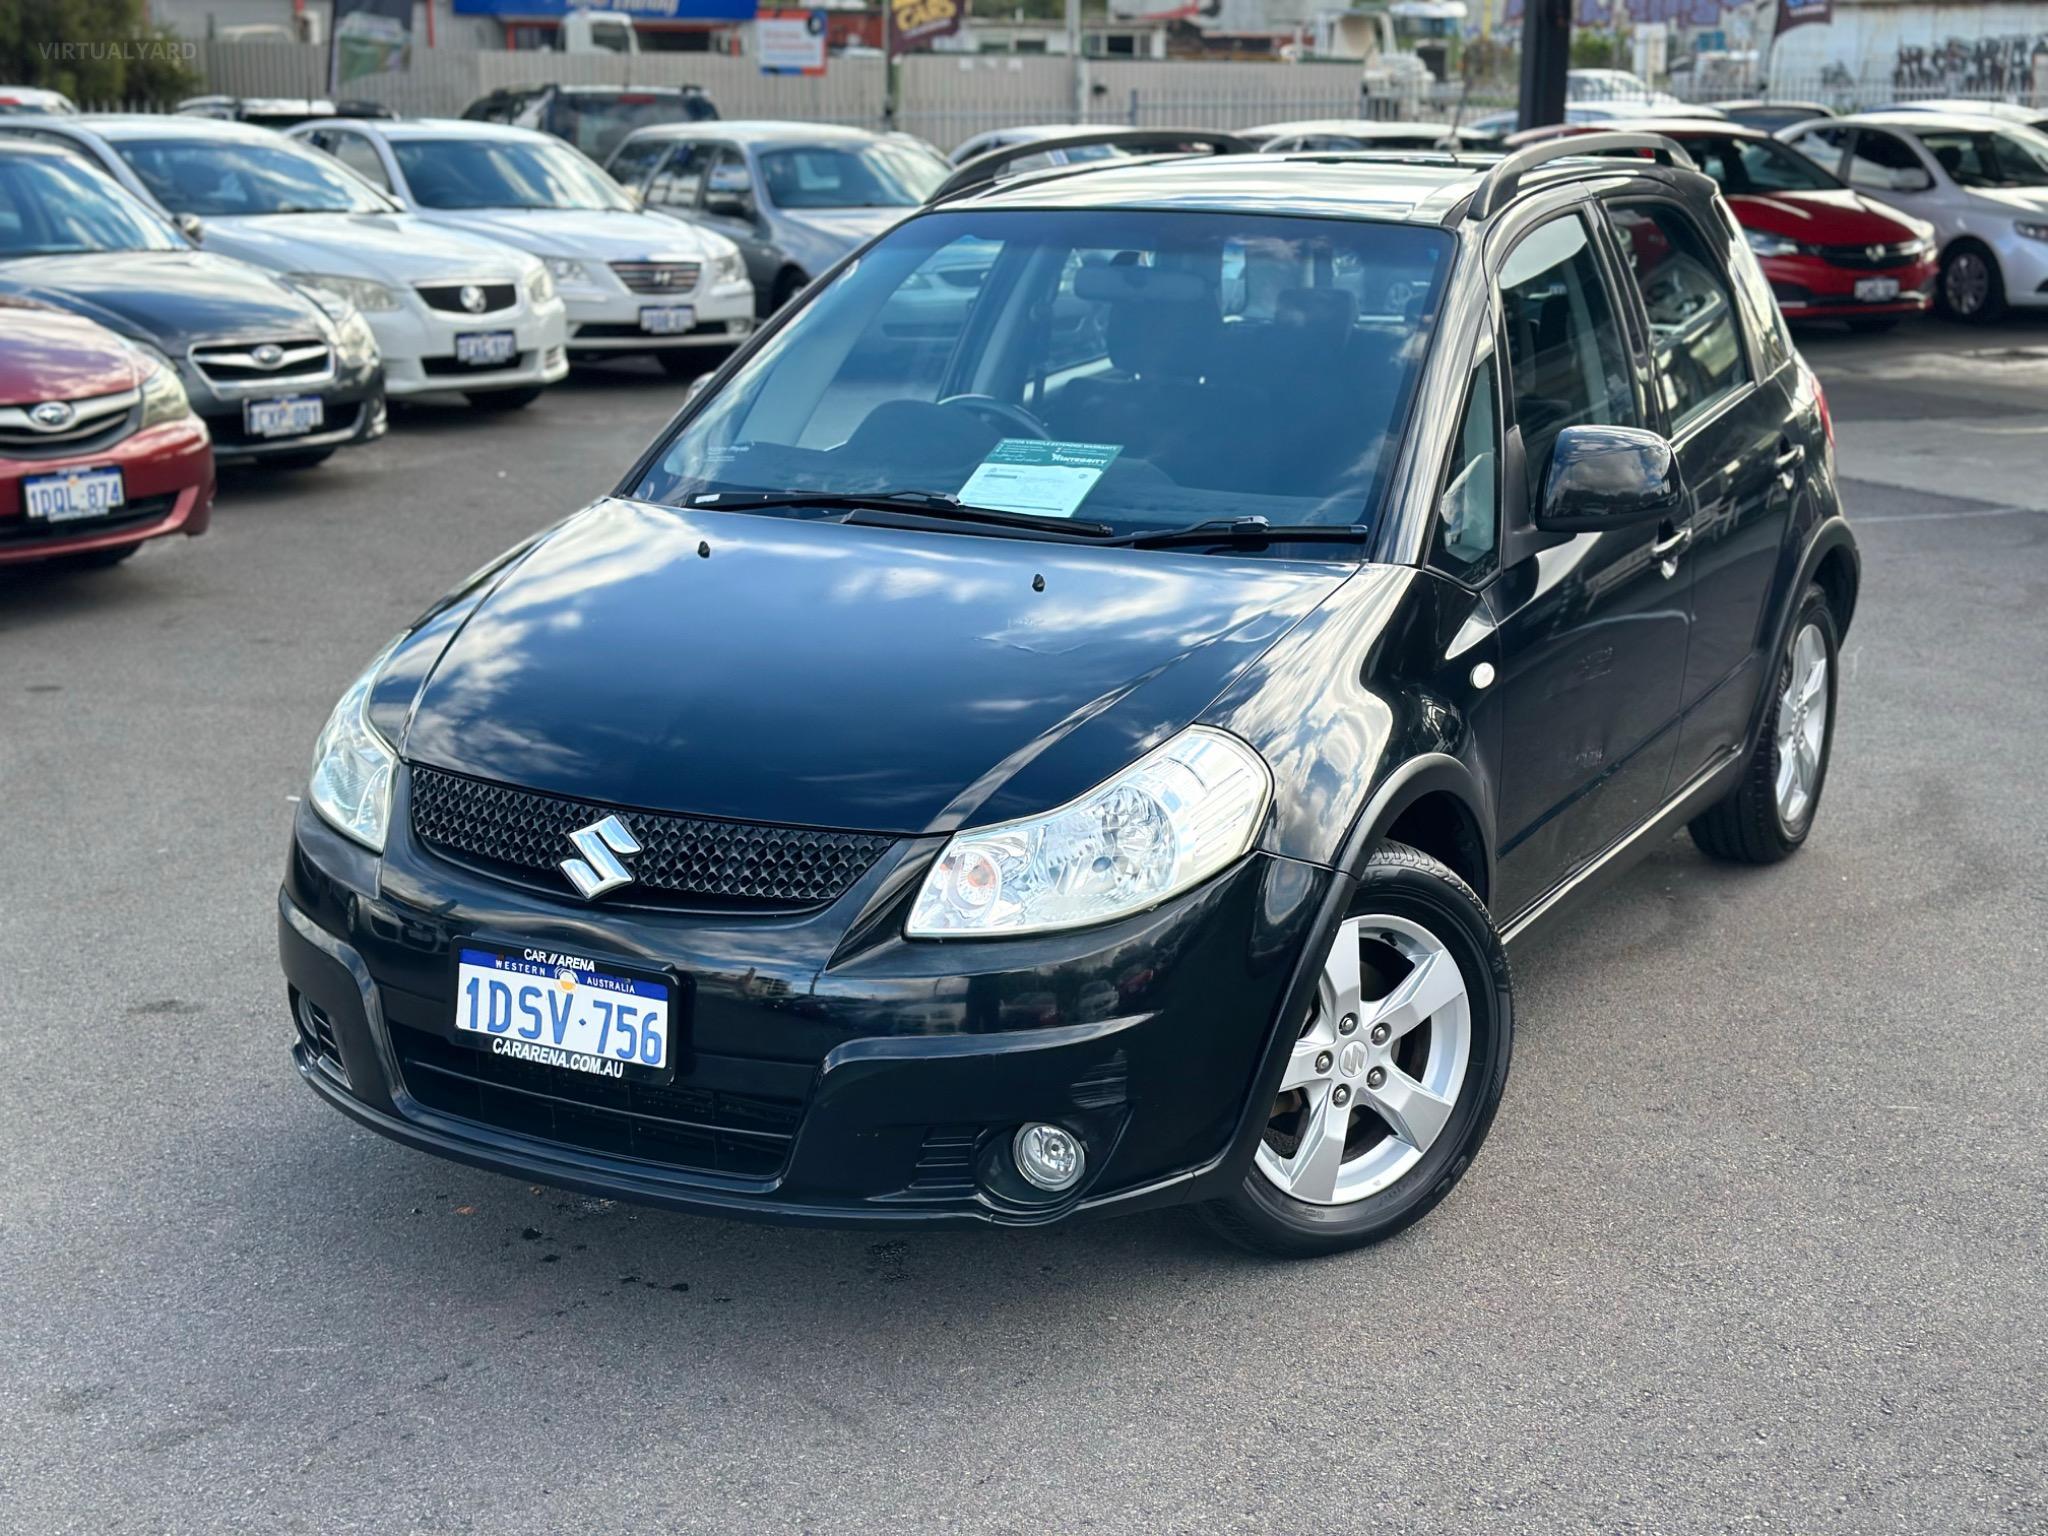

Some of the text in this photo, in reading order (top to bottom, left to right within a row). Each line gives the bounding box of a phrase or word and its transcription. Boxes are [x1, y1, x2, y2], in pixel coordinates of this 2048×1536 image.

[523, 948, 547, 964] CAR
[495, 959, 636, 994] WESTERN AUSTRALIA
[492, 1037, 624, 1079] CARARENA.COM.AU
